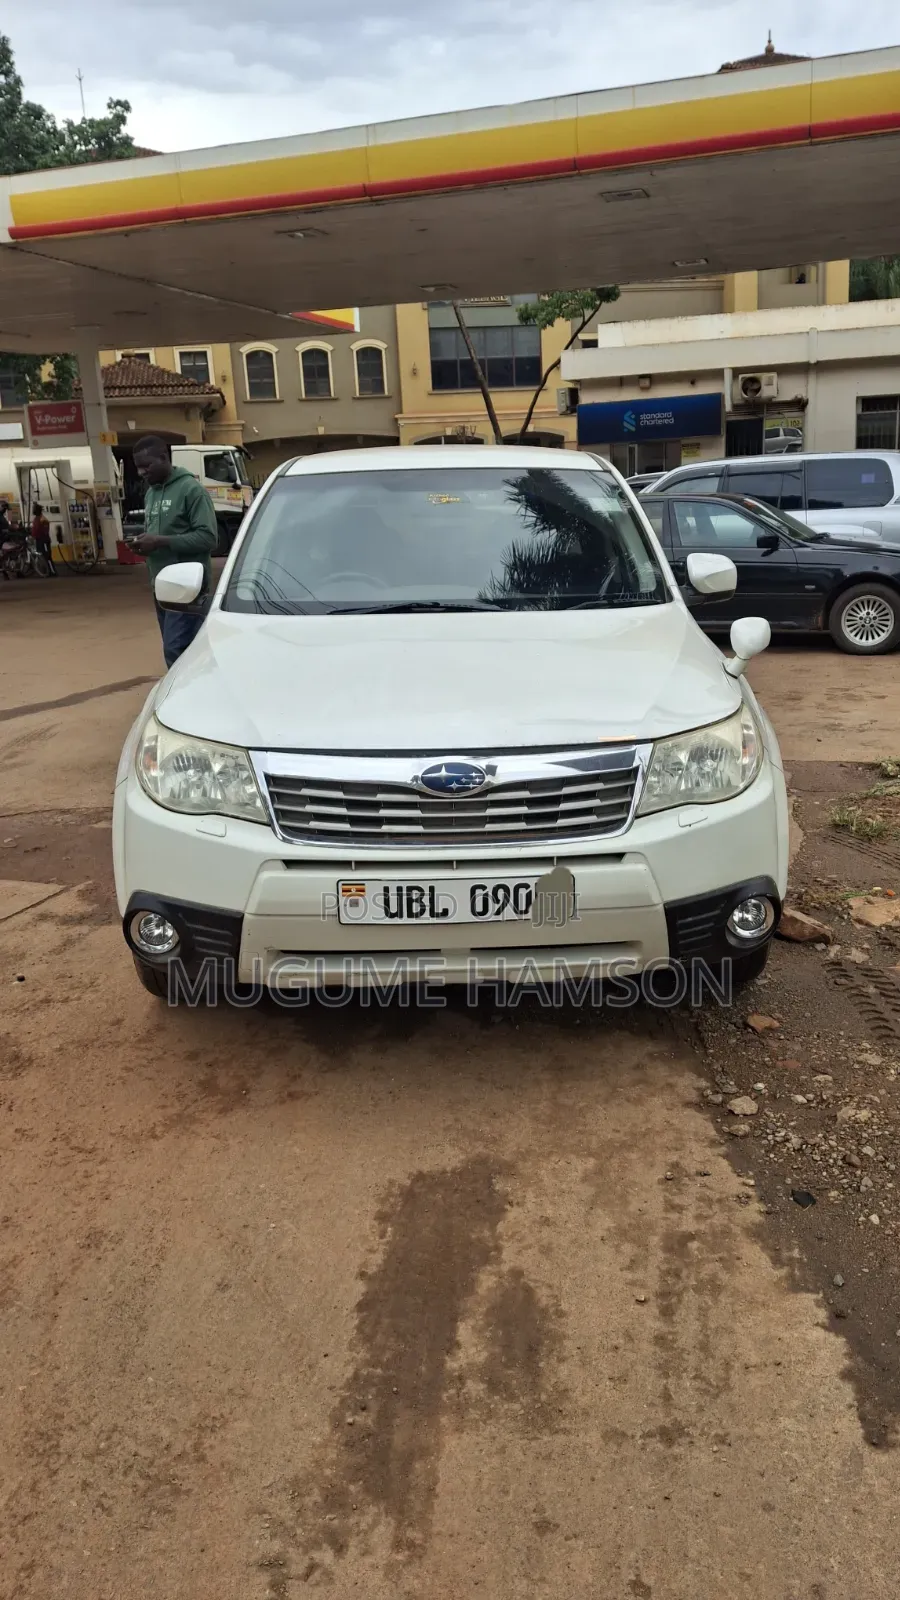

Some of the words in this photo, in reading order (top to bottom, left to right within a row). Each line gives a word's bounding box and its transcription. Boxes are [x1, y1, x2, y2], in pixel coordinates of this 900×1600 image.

[35, 414, 77, 425] V-Power
[639, 412, 673, 420] standard
[639, 418, 675, 426] chartered
[382, 884, 449, 919] UBL
[470, 882, 538, 917] 090
